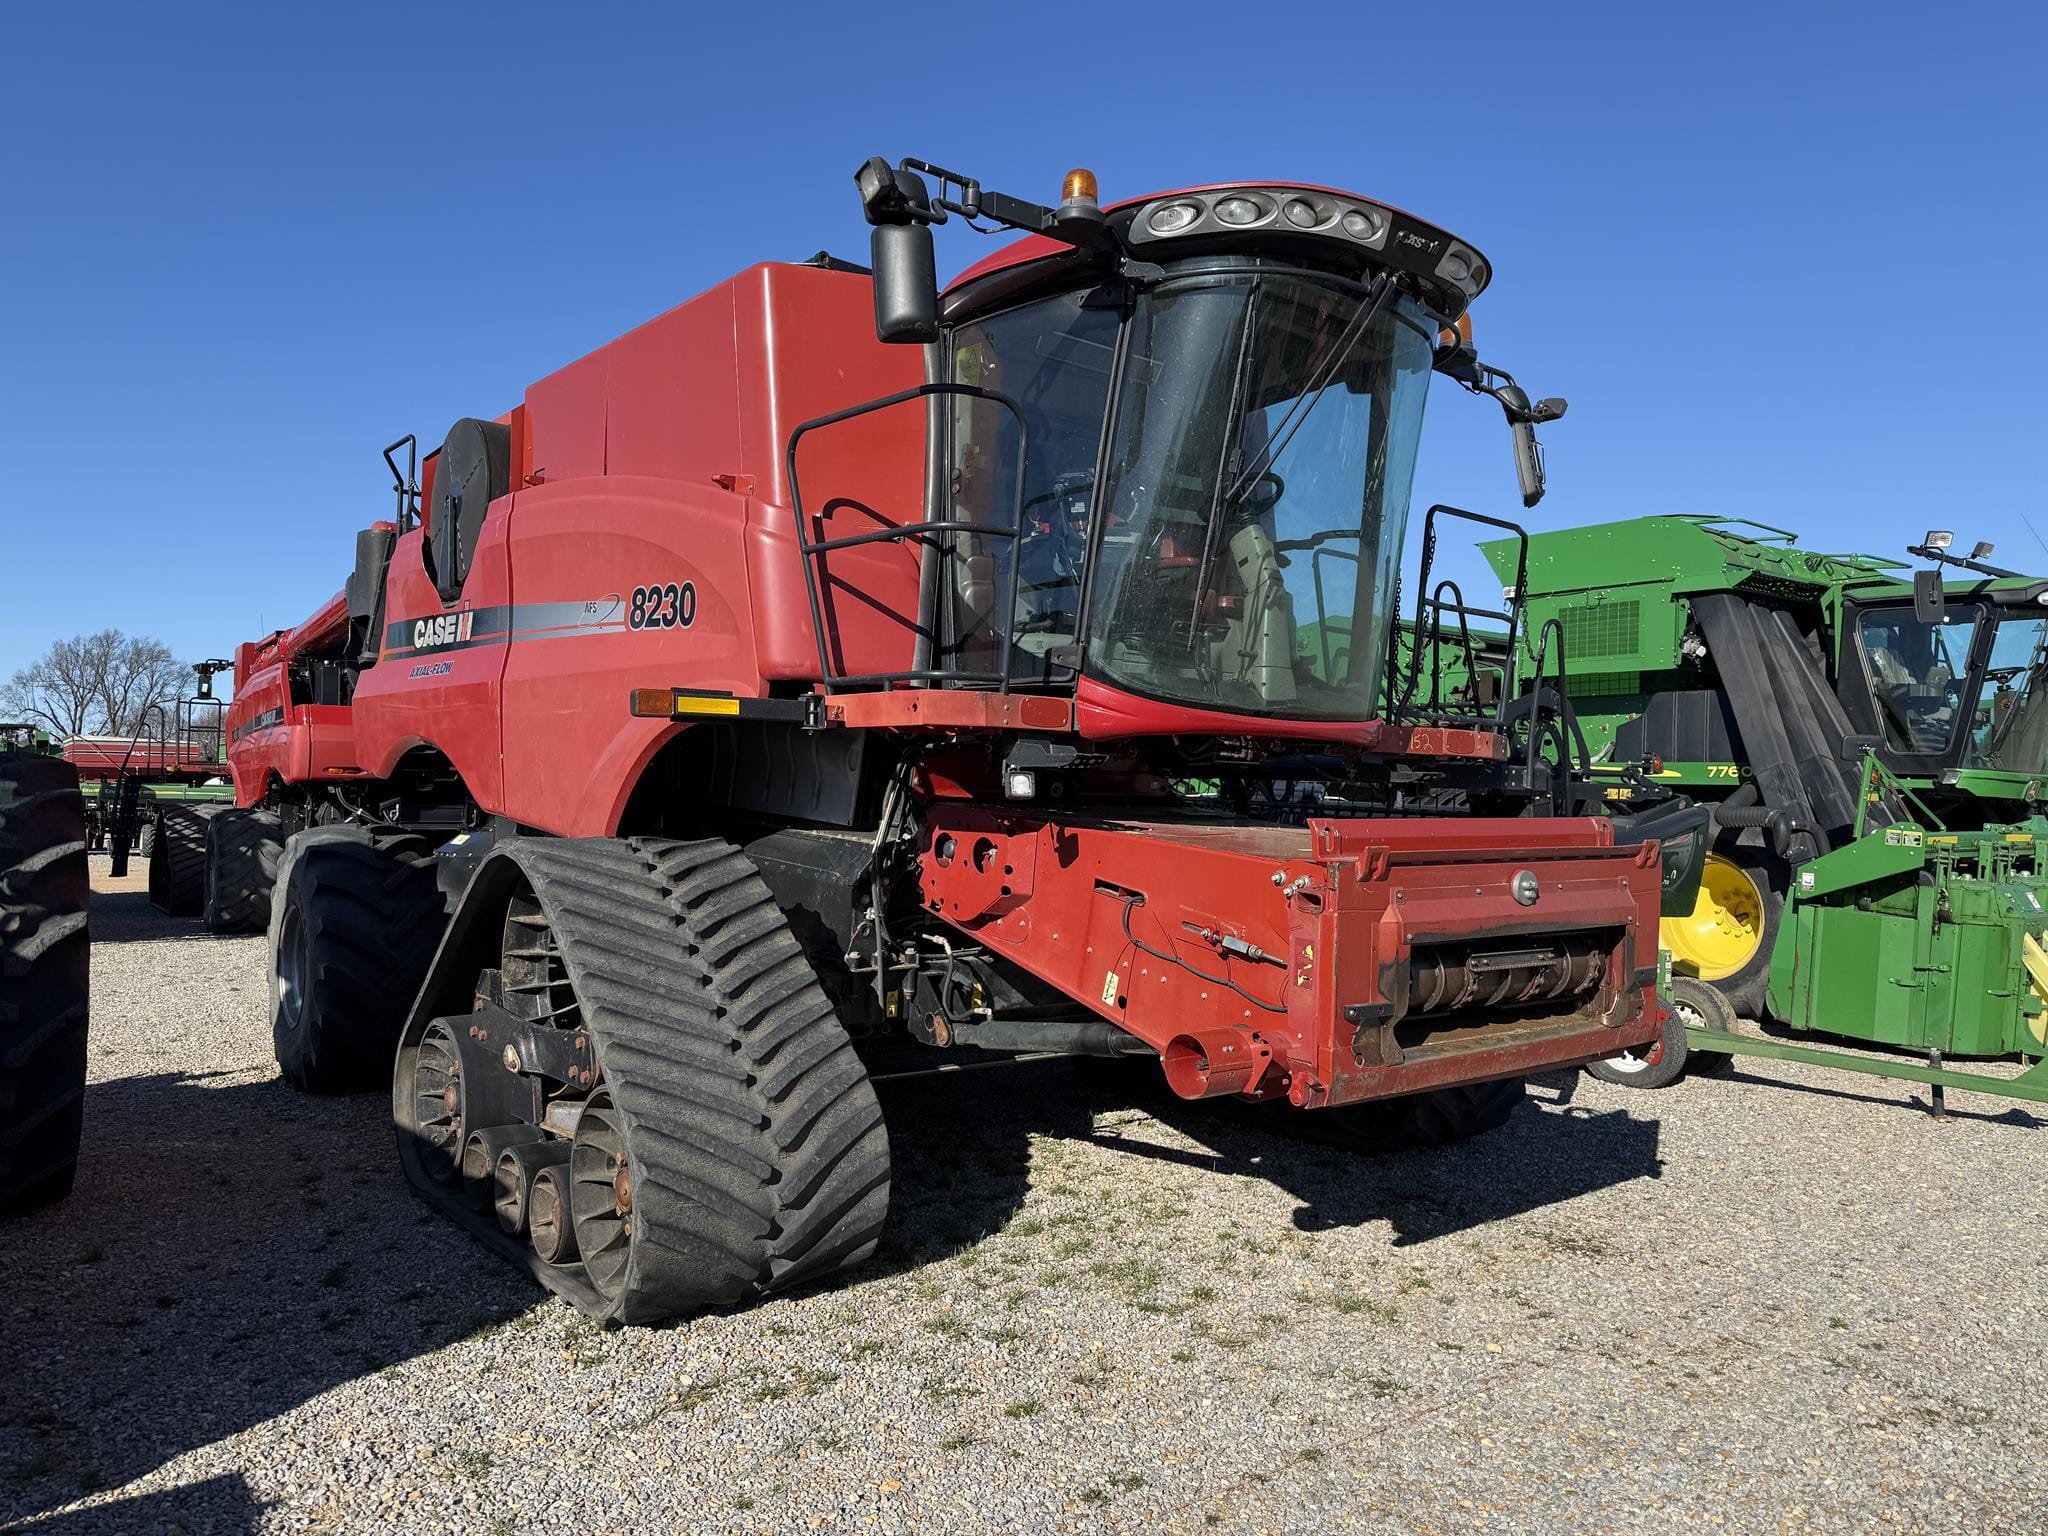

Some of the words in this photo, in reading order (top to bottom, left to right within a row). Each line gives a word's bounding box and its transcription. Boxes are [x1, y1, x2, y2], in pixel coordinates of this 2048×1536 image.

[584, 602, 598, 614] AFS
[629, 581, 697, 631] 8230
[413, 614, 457, 648] CASE
[409, 660, 455, 679] AXIAL-FLOW
[1410, 733, 1434, 751] 152
[1706, 765, 1754, 778] 7760
